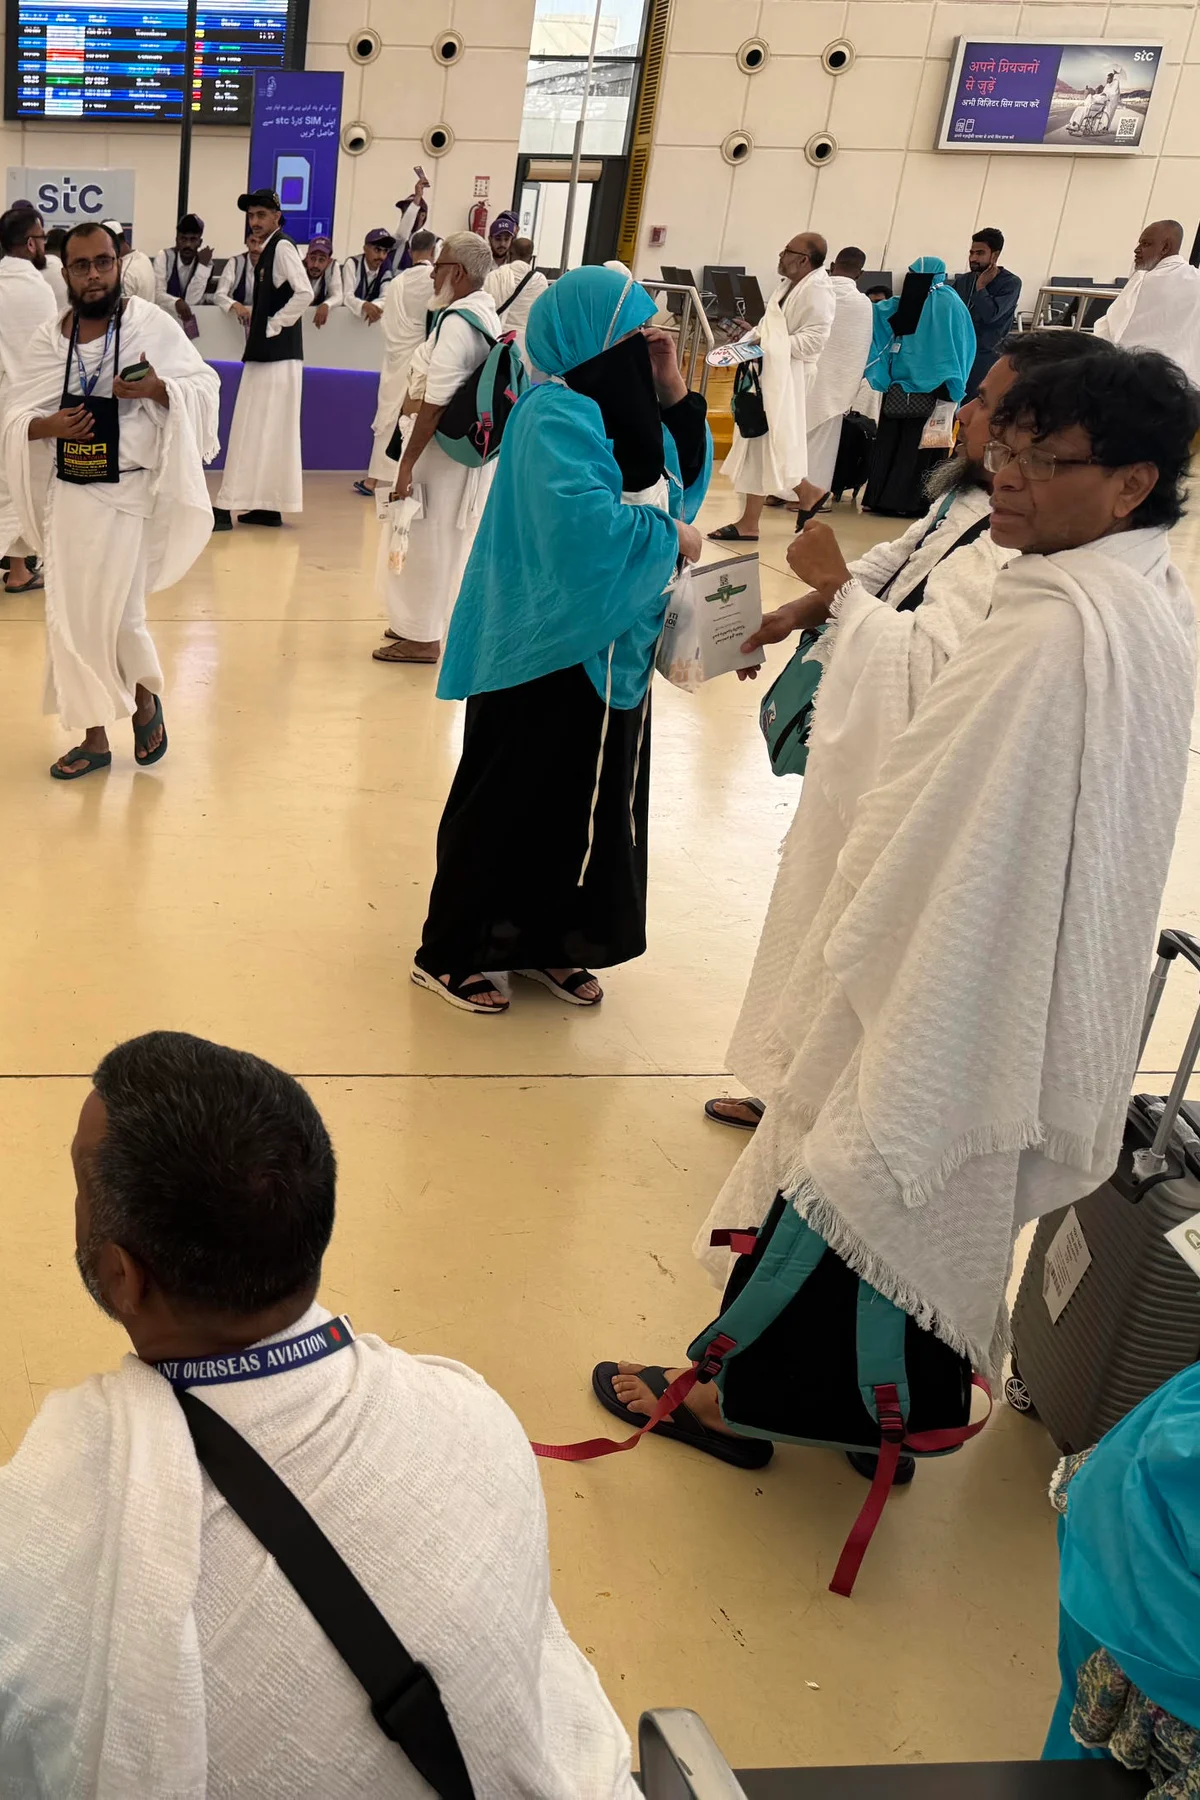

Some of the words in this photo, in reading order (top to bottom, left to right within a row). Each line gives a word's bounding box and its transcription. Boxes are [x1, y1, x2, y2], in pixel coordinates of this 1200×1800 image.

[1133, 50, 1154, 62] stc
[969, 58, 996, 72] अपने
[998, 58, 1040, 74] प्रियजनों
[966, 76, 975, 91] से
[275, 116, 290, 125] stc
[305, 116, 322, 125] SIM
[322, 118, 336, 128] اپنی
[300, 128, 316, 138] کریں
[316, 129, 335, 138] حاصل
[38, 177, 104, 214] stc
[63, 442, 107, 455] IQRA
[183, 1354, 261, 1379] OVERSEAS
[267, 1333, 328, 1368] AVIATION
